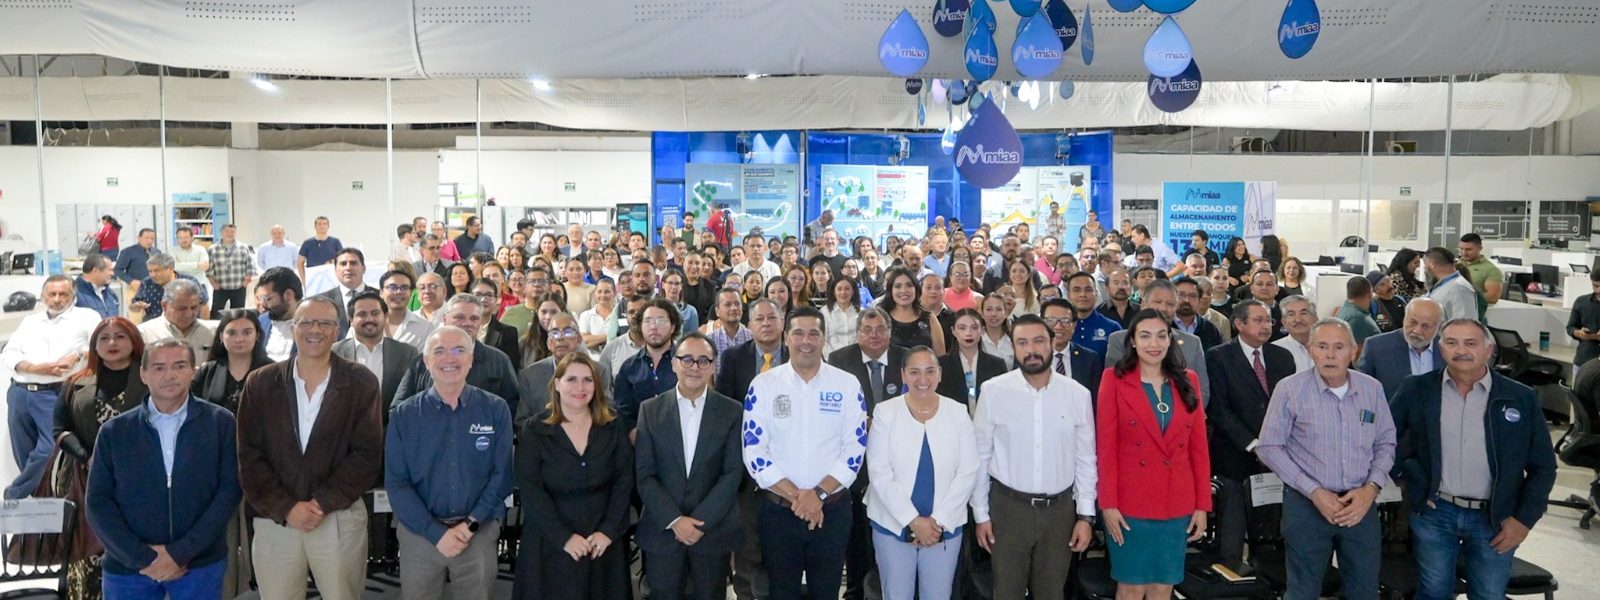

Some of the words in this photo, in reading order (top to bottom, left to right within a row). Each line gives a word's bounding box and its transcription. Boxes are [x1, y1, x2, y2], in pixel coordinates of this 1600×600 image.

[1055, 26, 1076, 37] miaa
[1297, 22, 1320, 37] miaa
[901, 48, 926, 59] miaa
[1036, 48, 1060, 58] miaa
[1165, 51, 1188, 59] miaa
[980, 55, 997, 66] miaa
[1171, 79, 1199, 92] miaa
[985, 148, 1020, 164] miaa
[1202, 191, 1221, 199] miaa
[1170, 204, 1223, 213] CAPACIDAD
[1225, 205, 1238, 213] DE
[1170, 213, 1237, 222] ALMACENAMIENTO
[1259, 216, 1272, 229] miaa
[1170, 222, 1200, 230] ENTRE
[1202, 222, 1236, 231] TODOS
[819, 391, 843, 402] LEO
